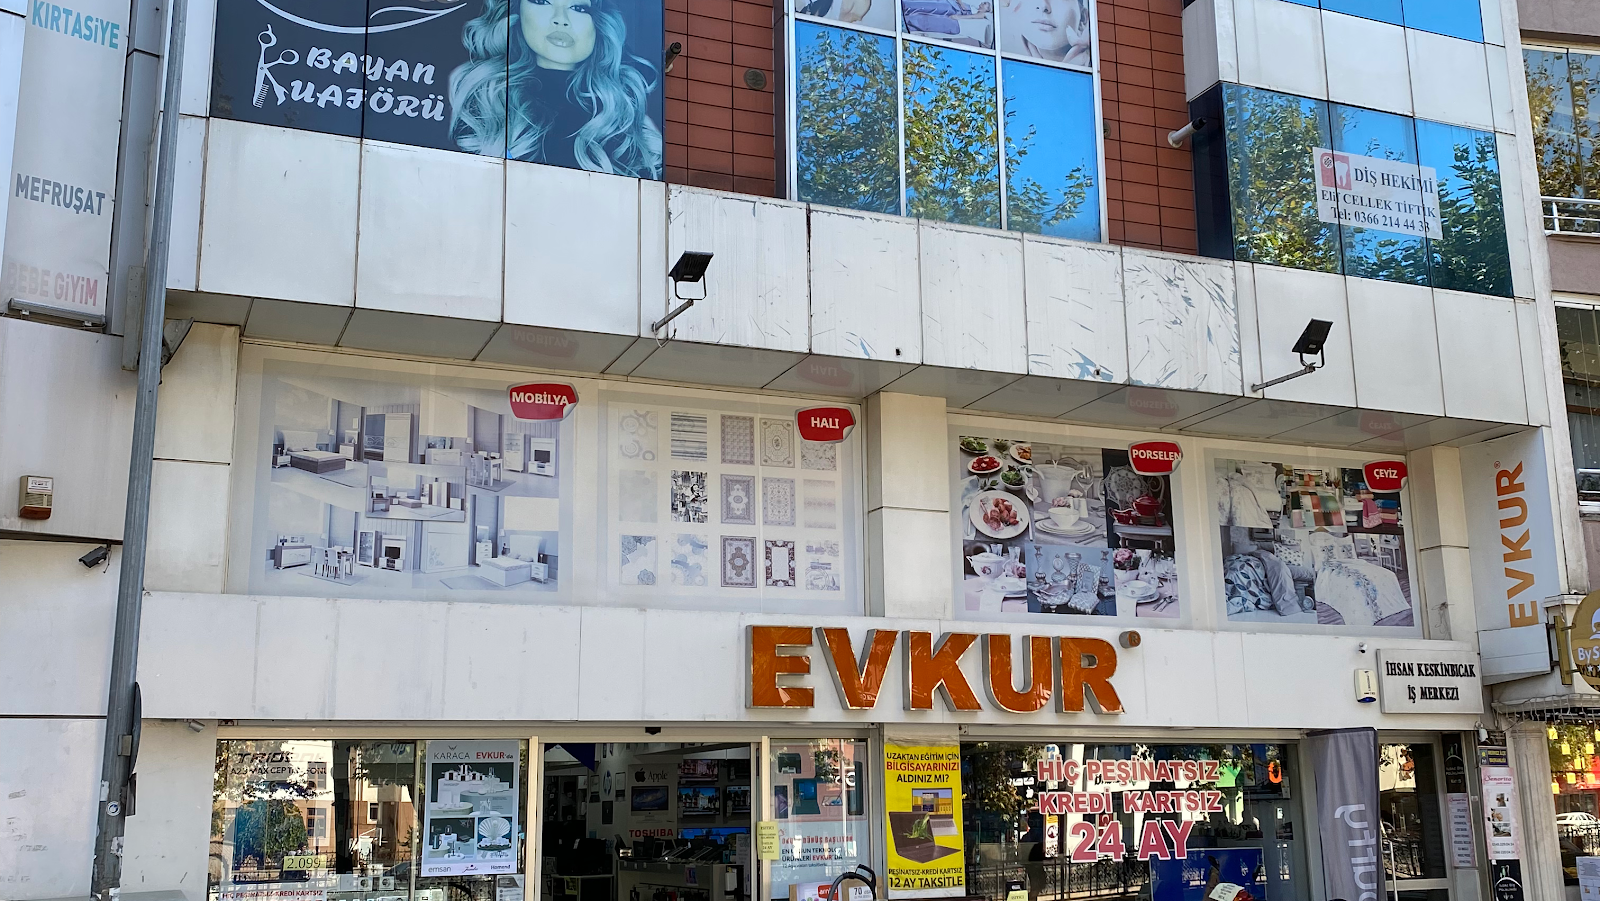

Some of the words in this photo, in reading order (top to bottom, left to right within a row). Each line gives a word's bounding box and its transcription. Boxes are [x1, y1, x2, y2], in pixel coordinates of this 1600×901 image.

[306, 46, 436, 85] BAYAN
[1354, 166, 1377, 188] DİŞ
[1380, 172, 1434, 194] HEKİMİ
[15, 173, 106, 216] MEFRUŞAT
[1354, 210, 1379, 226] 0366
[1382, 215, 1400, 228] 214
[1403, 218, 1416, 231] 44
[6, 262, 50, 299] BEBE
[512, 390, 570, 407] MOBİLYA
[810, 415, 840, 430] HALI
[1131, 448, 1182, 461] PORSELEN
[1373, 466, 1398, 480] ÇEYİZ
[1496, 461, 1539, 628] EVKUR
[746, 625, 1126, 716] EVKUR
[1386, 661, 1415, 676] İHSAN
[1407, 685, 1416, 704] İŞ
[434, 752, 470, 760] KARACA
[886, 752, 919, 761] UZAKTAN
[920, 753, 944, 761] EĞİTİM
[945, 753, 960, 762] İÇİN
[270, 766, 286, 774] CEP
[886, 760, 960, 772] BİLGİSAYARINIZI
[1037, 753, 1080, 787] HİÇ
[1086, 757, 1220, 786] PEŞİNATSIZ
[648, 770, 668, 782] Apple
[896, 774, 932, 783] ALDINIZ
[934, 774, 950, 783] MI?
[1038, 788, 1113, 815] KREDİ
[1123, 790, 1223, 813] KARTSIZ
[629, 828, 674, 838] TOSHIBA
[1070, 820, 1126, 864] 24
[1137, 819, 1194, 861] AY
[286, 857, 321, 870] 2.099
[939, 866, 962, 875] KARTSIZ
[889, 876, 901, 888] 12
[903, 877, 916, 888] AY
[917, 874, 963, 888] TAKSİTLE
[854, 887, 862, 895] 70
